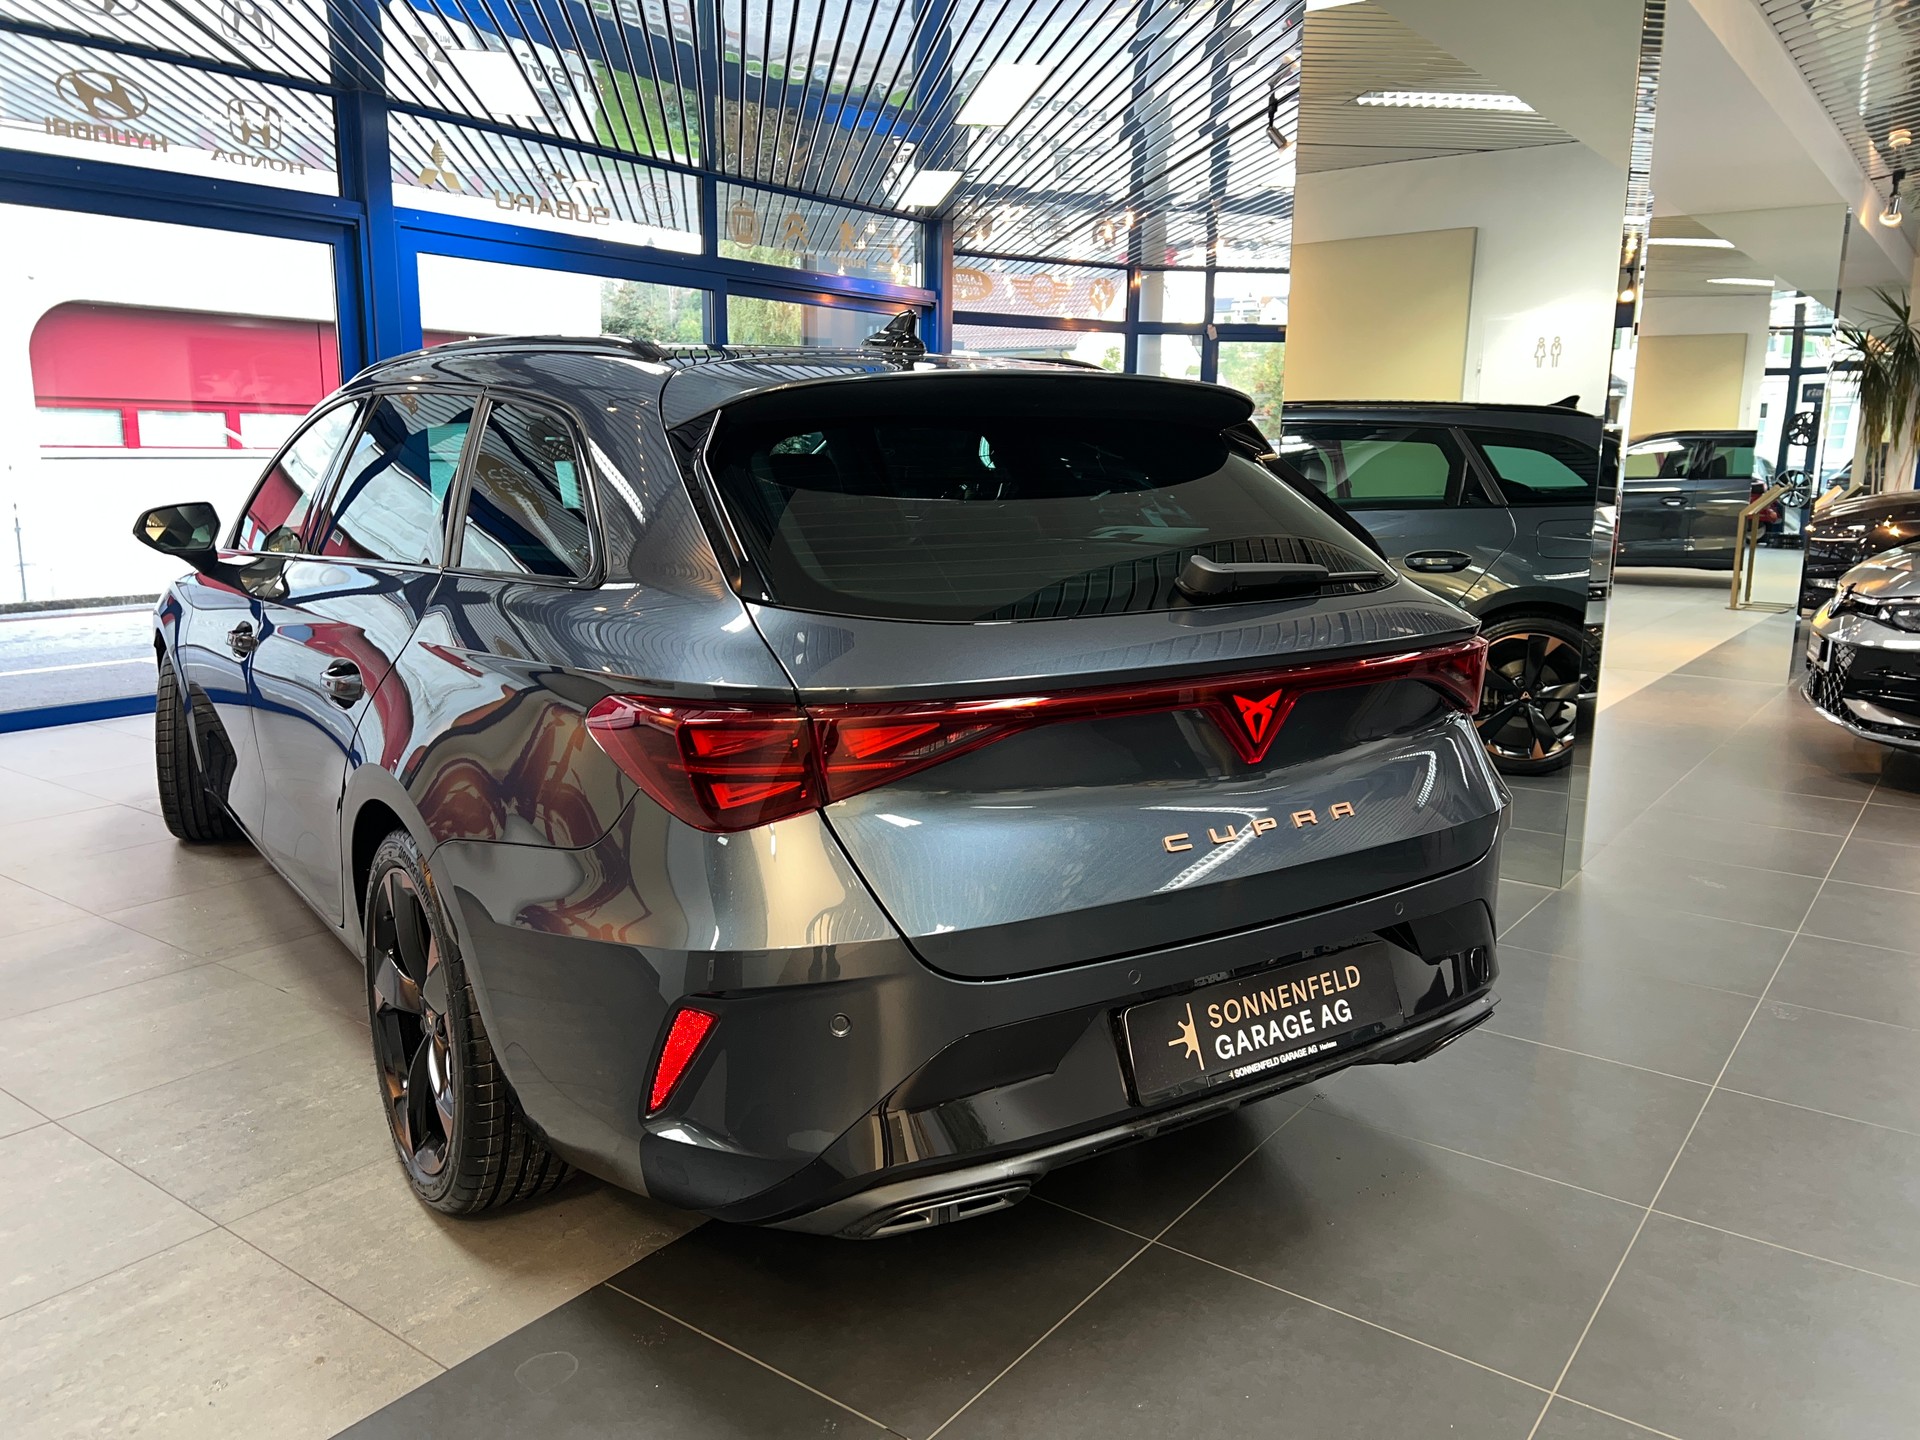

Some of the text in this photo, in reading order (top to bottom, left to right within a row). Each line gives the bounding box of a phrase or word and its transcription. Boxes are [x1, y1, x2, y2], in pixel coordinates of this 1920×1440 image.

[1162, 801, 1355, 853] CUPRA
[1207, 964, 1361, 1029] SONNENFELD
[1215, 999, 1353, 1060] GARAGE AG
[1234, 1056, 1279, 1078] SONNENFELD
[1280, 1048, 1307, 1063] GARAGE
[1307, 1044, 1319, 1055] AG
